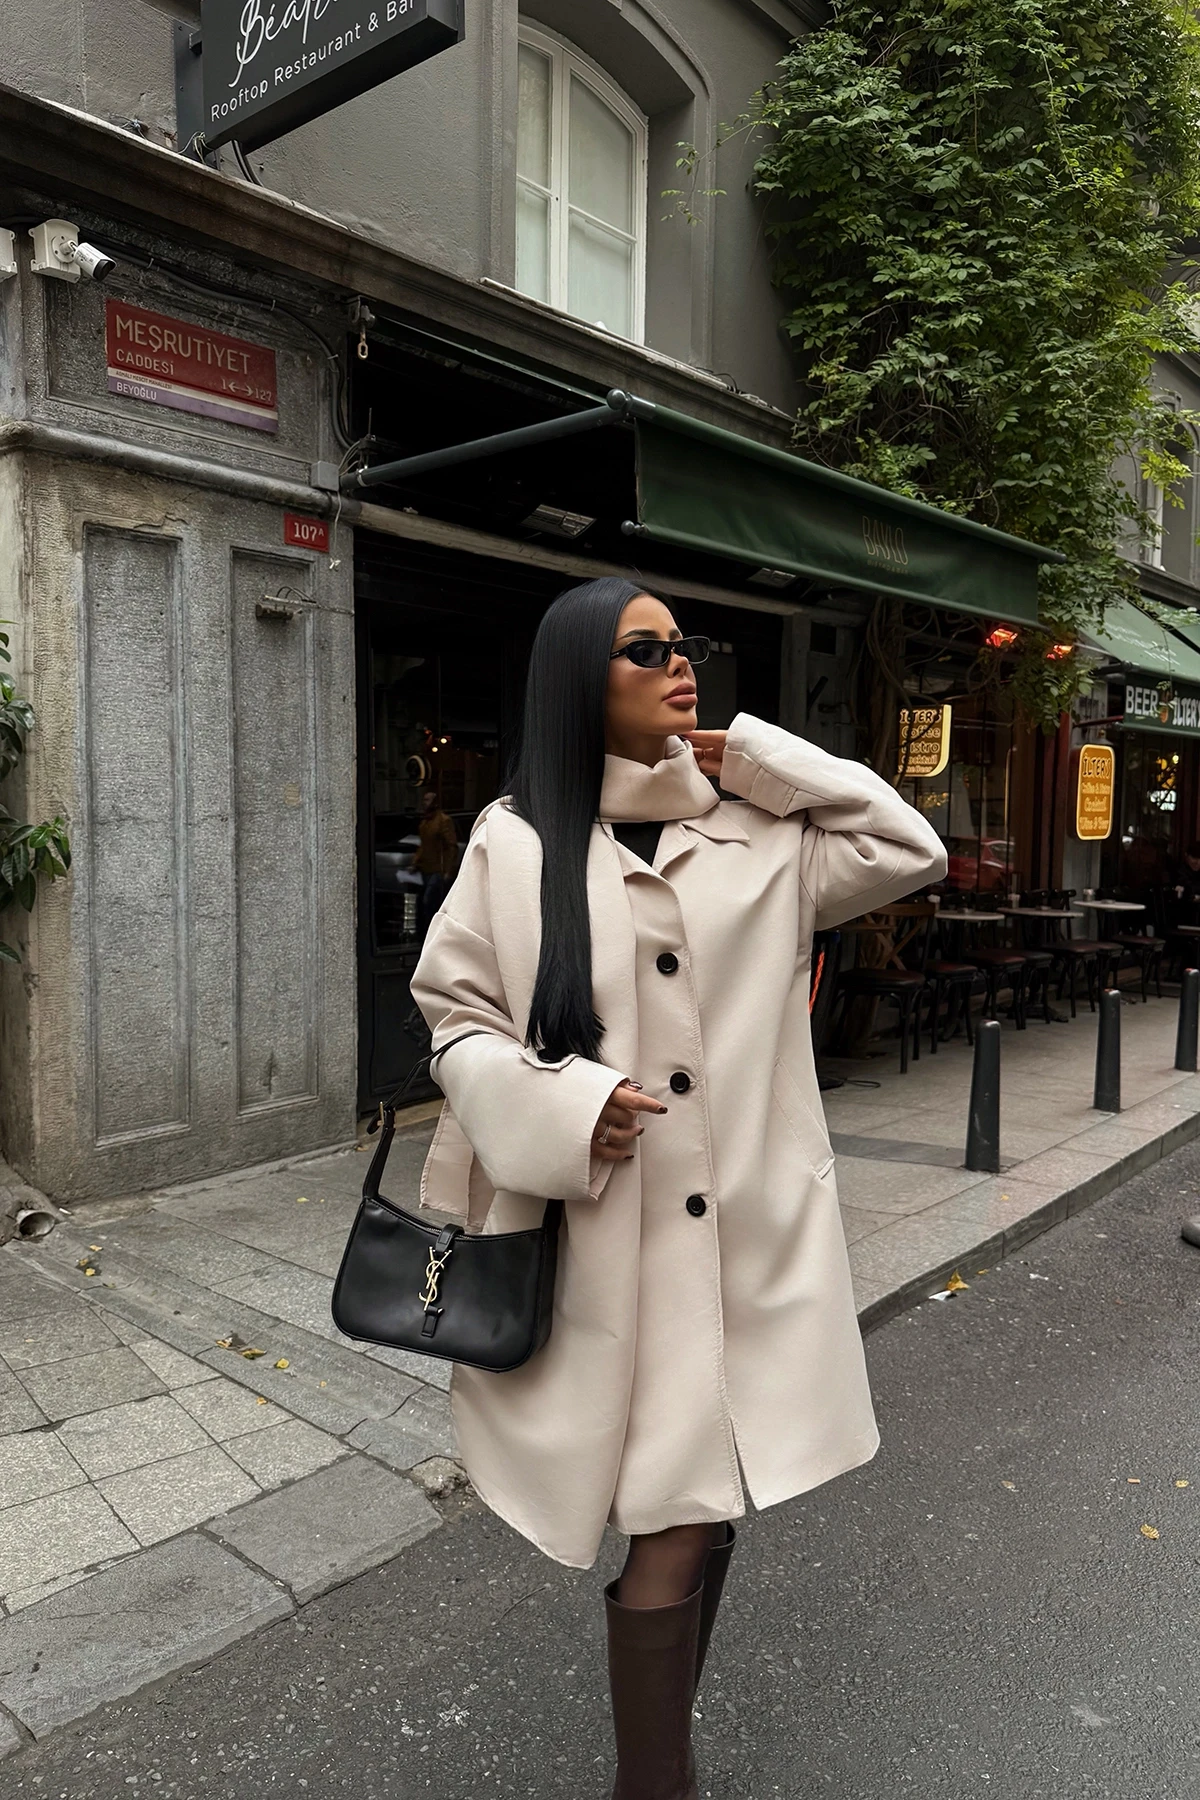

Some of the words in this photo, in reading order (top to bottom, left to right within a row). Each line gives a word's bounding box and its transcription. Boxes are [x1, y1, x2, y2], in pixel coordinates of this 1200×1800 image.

[210, 79, 269, 122] Rooftop
[274, 22, 361, 86] Restaurant
[368, 12, 379, 32] &
[115, 314, 251, 375] MEŞRUTİYET
[116, 348, 175, 376] CADDESİ
[116, 382, 157, 401] BEYOĞLU
[1125, 685, 1159, 717] BEER
